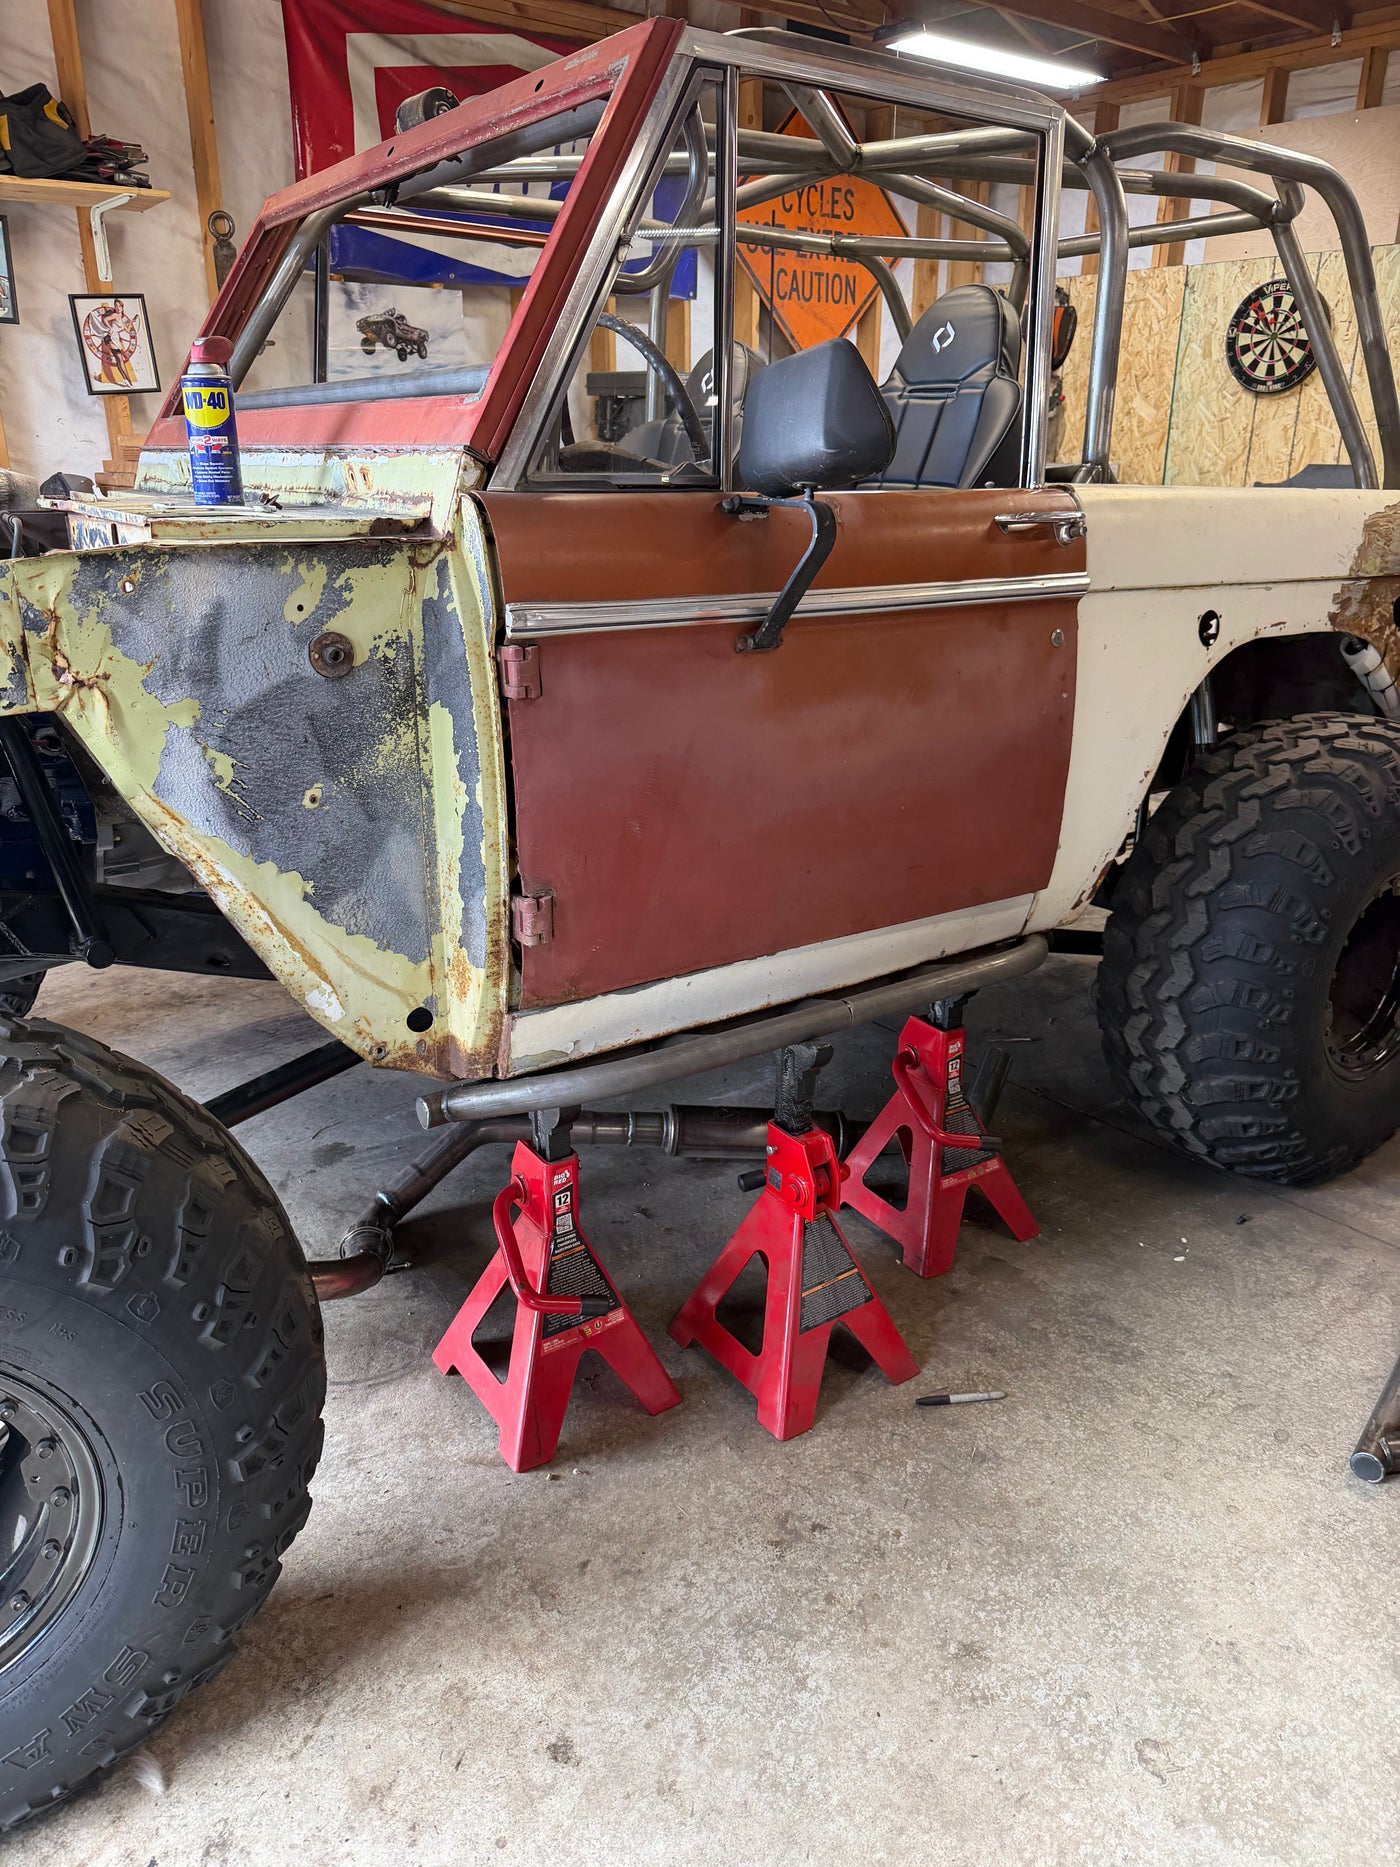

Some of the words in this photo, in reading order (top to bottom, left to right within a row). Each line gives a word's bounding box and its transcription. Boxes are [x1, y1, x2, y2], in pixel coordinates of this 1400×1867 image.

[781, 184, 855, 221] CYCLES
[776, 268, 856, 305] CAUTION
[184, 391, 226, 410] WD-40
[203, 435, 211, 445] 2
[950, 1060, 959, 1070] 12
[553, 1177, 567, 1186] RED
[556, 1193, 569, 1206] 12
[136, 1380, 209, 1608] SUPER
